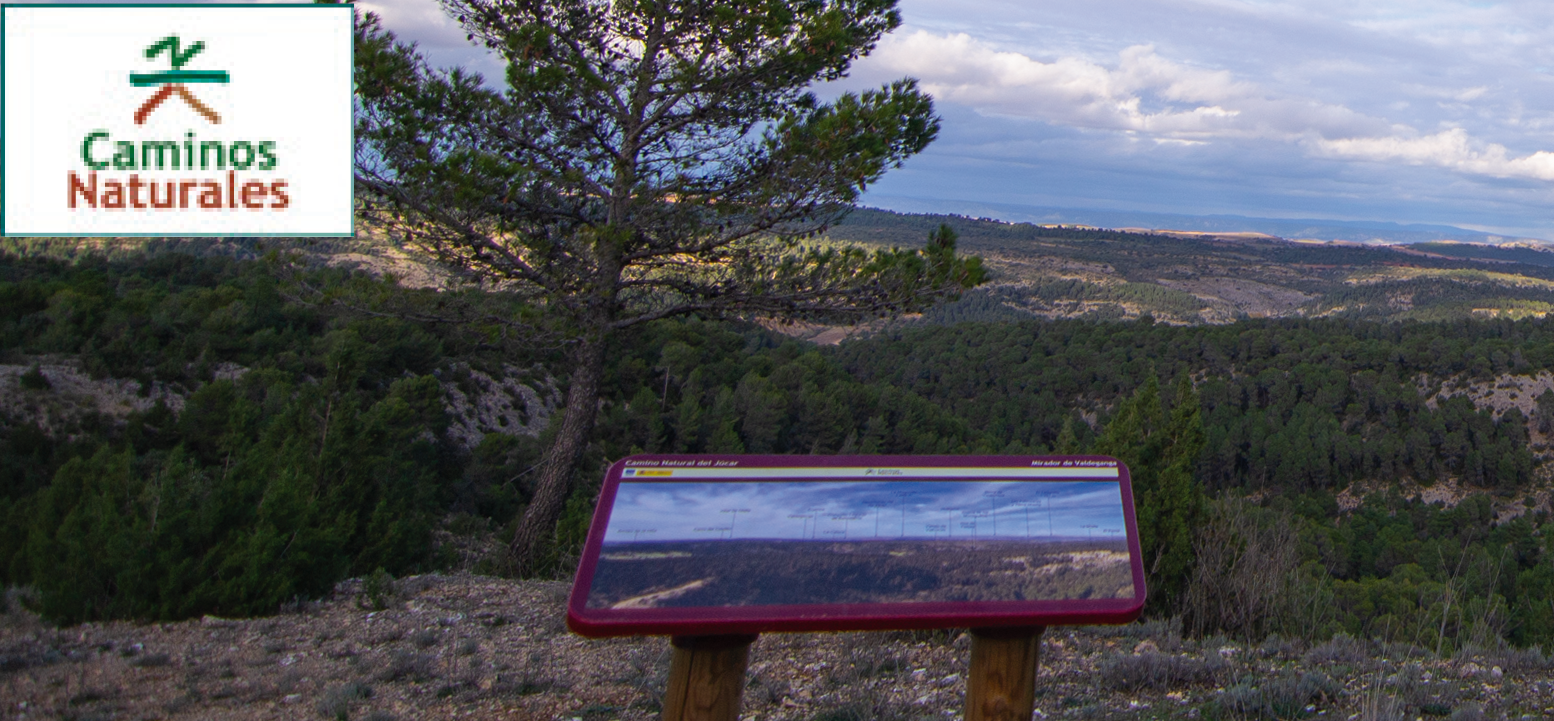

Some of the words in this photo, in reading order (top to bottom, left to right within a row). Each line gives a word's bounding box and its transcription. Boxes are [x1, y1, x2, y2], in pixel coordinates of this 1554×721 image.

[625, 459, 660, 467] Camino
[661, 459, 696, 467] Natural
[697, 459, 712, 467] del
[714, 459, 740, 467] Júcar
[1031, 459, 1061, 467] Mirador
[1062, 459, 1073, 467] de
[1074, 459, 1118, 468] Valdeganga
